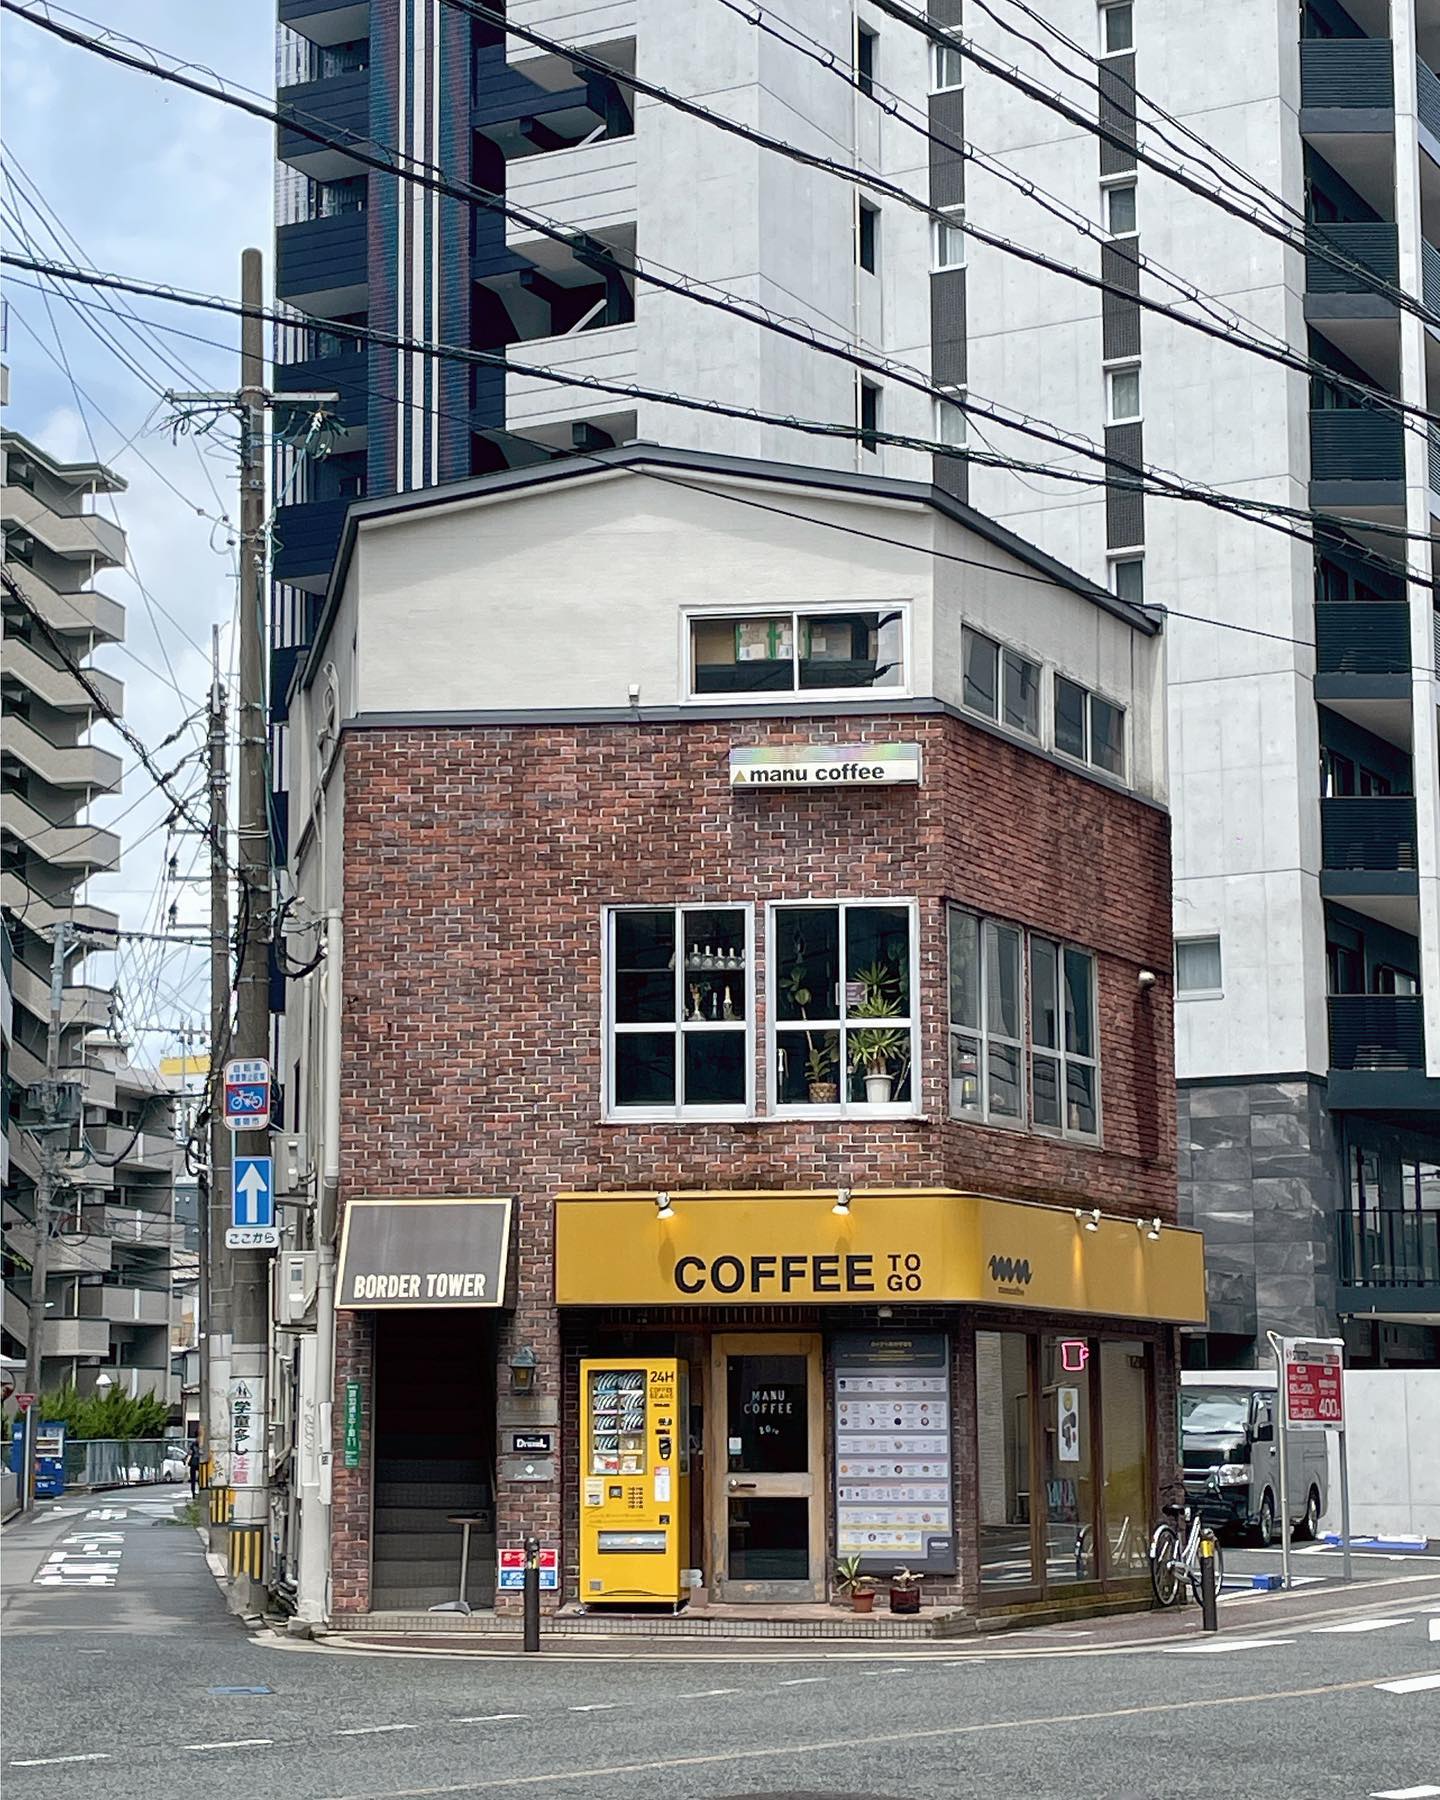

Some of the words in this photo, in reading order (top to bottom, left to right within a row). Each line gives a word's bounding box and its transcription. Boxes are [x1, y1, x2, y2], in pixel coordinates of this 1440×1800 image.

[750, 766, 808, 783] manu
[815, 763, 885, 781] coffee
[229, 1232, 275, 1244] ここから
[674, 1254, 875, 1293] COFFEE
[887, 1253, 922, 1271] TO
[353, 1274, 421, 1298] BORDER
[426, 1273, 486, 1297] TOWER
[887, 1274, 922, 1292] GO
[650, 1371, 675, 1383] 24H
[751, 1390, 785, 1401] MANU
[743, 1402, 793, 1414] COFFEE
